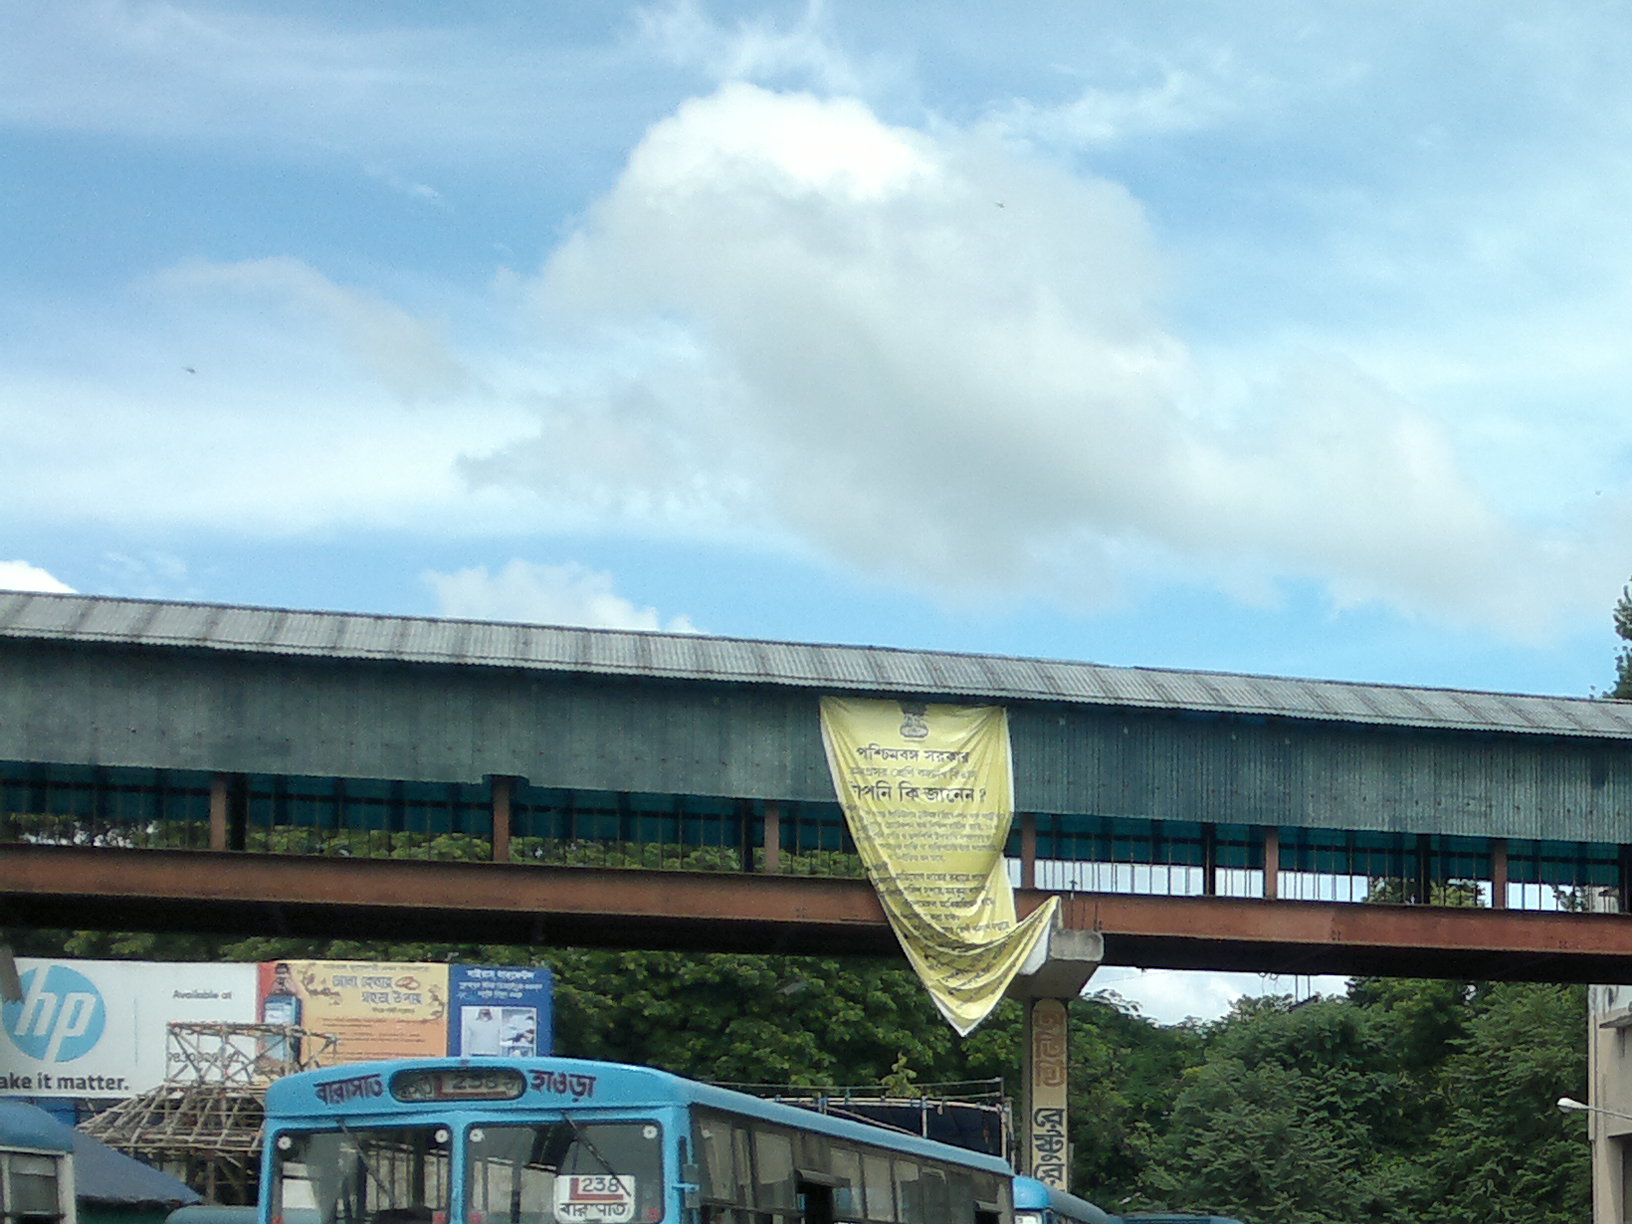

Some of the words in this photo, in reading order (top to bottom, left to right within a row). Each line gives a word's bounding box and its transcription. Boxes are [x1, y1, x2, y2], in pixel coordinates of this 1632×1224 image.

[14, 965, 97, 1062] hp
[37, 1071, 52, 1090] it
[57, 1074, 130, 1090] matter.
[313, 1073, 384, 1105] বারাসাত
[528, 1069, 597, 1103] হাওড়া
[581, 1177, 620, 1192] 238
